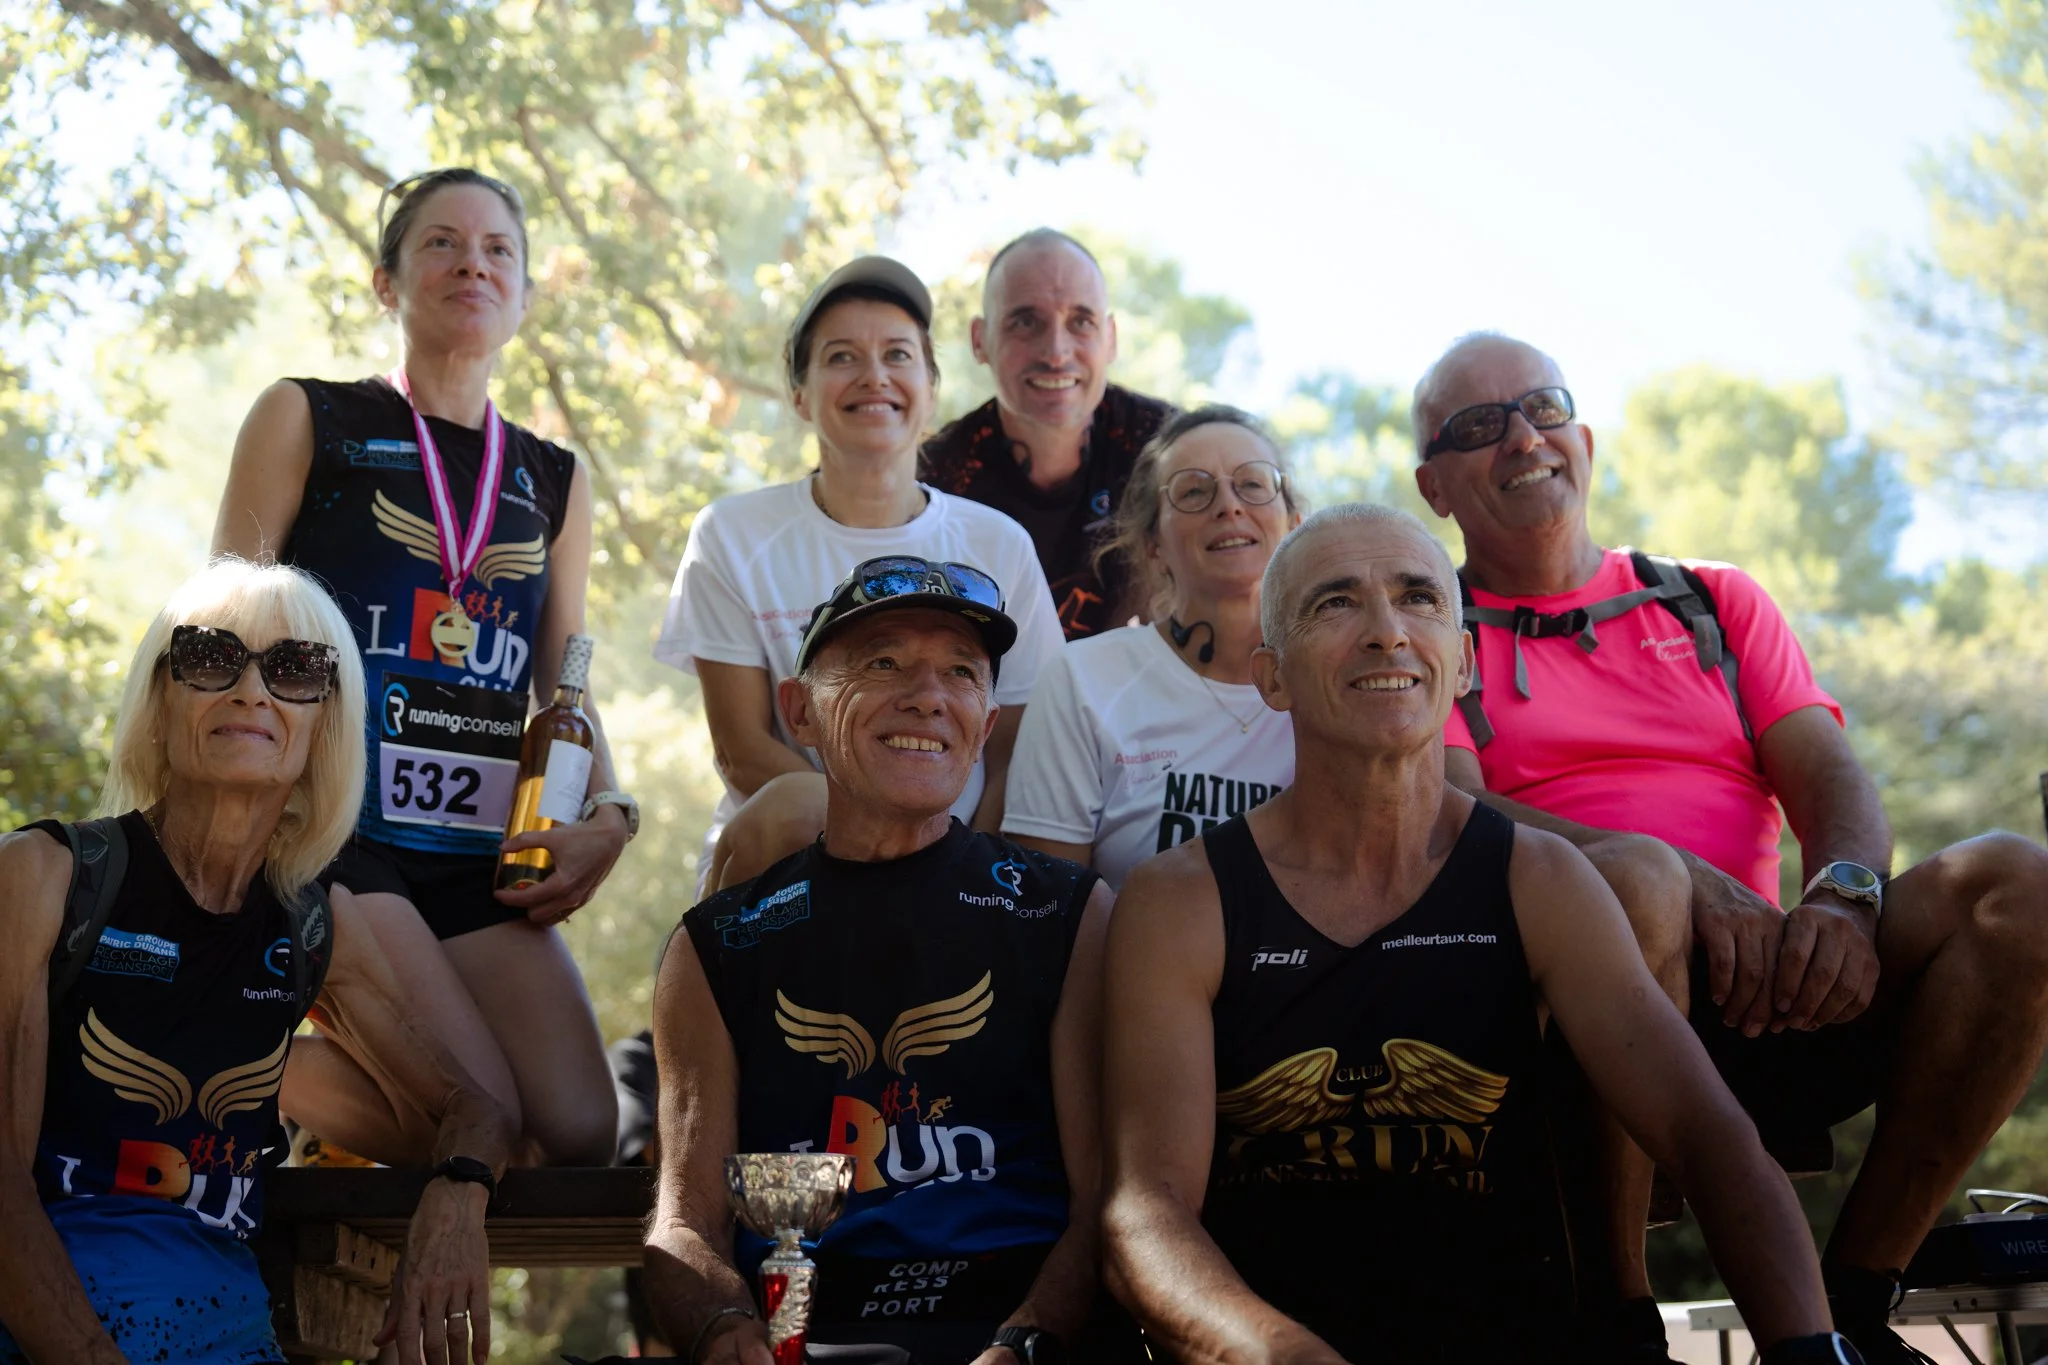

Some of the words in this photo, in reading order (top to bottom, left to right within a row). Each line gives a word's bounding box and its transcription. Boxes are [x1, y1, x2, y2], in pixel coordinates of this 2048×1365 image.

[365, 604, 407, 659] L
[391, 757, 482, 817] 532
[1163, 771, 1282, 818] NATUR
[99, 934, 132, 950] PATRIC
[133, 941, 177, 958] DURAND
[136, 933, 177, 951] GROUPE
[1381, 932, 1497, 951] meilleurtaux.com
[1250, 948, 1309, 972] poli
[1335, 1063, 1387, 1084] CLUB
[888, 1260, 969, 1279] COMP
[859, 1295, 944, 1320] PORT
